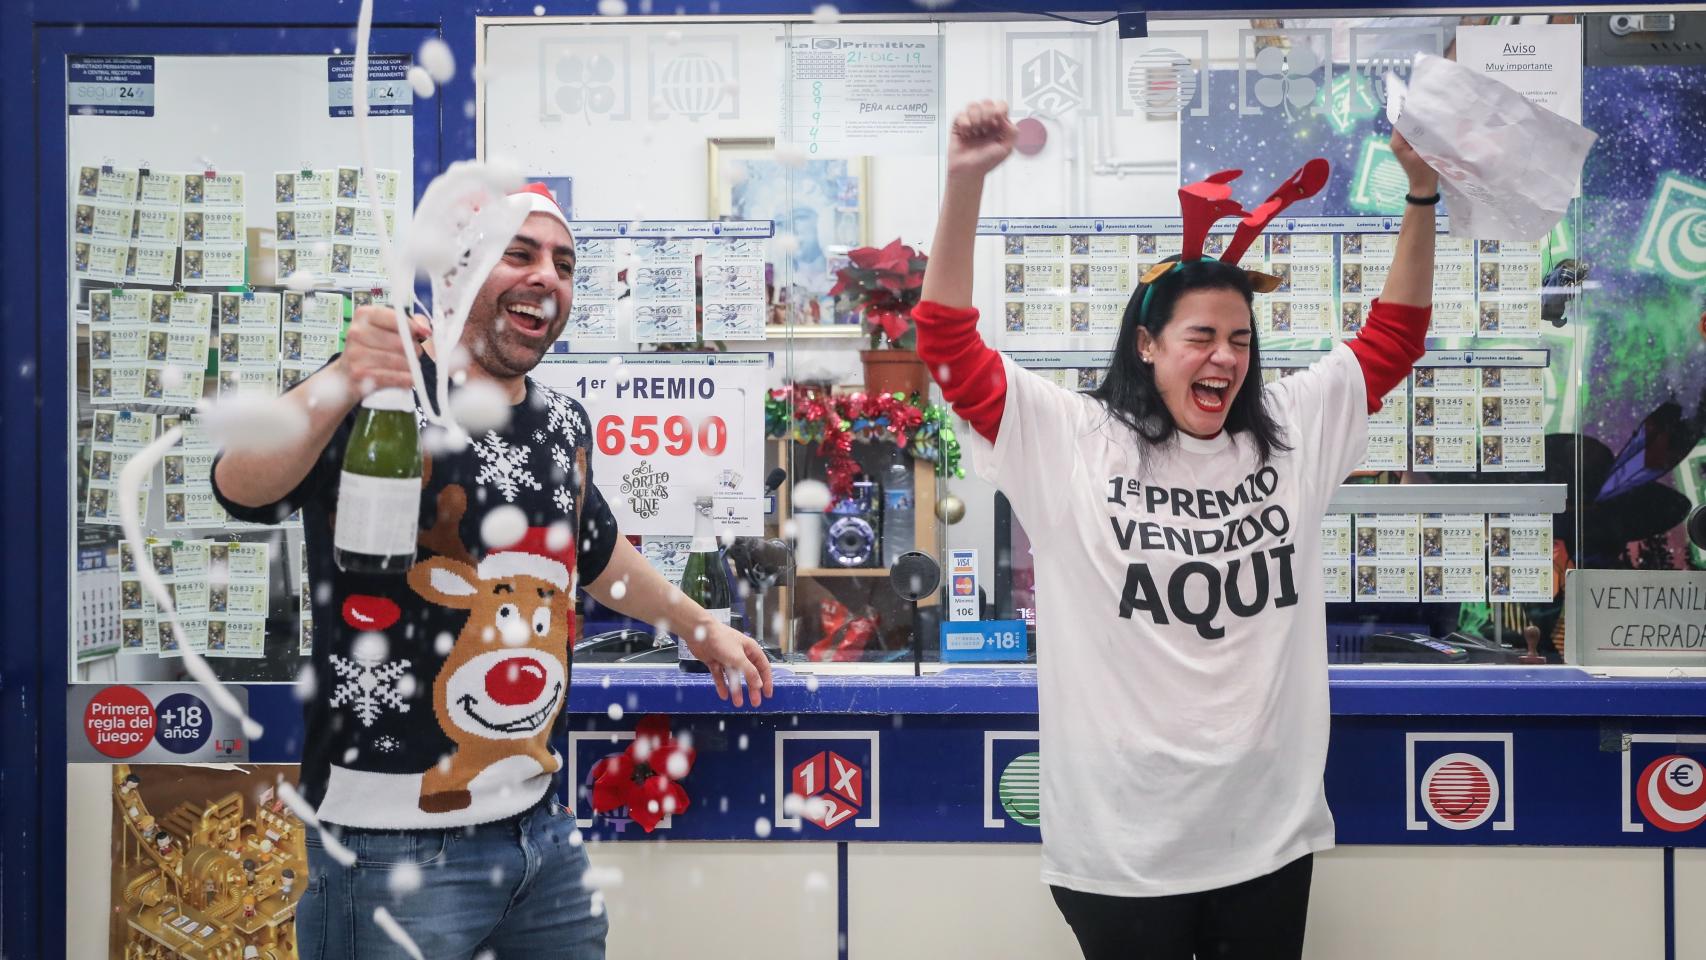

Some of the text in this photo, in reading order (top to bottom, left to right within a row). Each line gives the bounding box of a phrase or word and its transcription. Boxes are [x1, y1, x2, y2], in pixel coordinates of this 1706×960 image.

[1503, 43, 1536, 54] Aviso
[1486, 62, 1552, 71] Muy importante
[859, 102, 928, 114] PEÑA ALCAMPO
[616, 378, 715, 400] PREMIO
[596, 414, 728, 456] 6590
[620, 472, 669, 494] SORTEO
[632, 485, 668, 500] QUE NOS
[1145, 466, 1278, 520] PREMIO
[628, 497, 660, 520] UNE
[1110, 505, 1290, 556] VENDIDO
[1118, 538, 1299, 640] AQUÍ
[986, 632, 1014, 648] +18
[92, 703, 150, 715] Primera
[161, 706, 202, 728] +18
[88, 716, 153, 731] regla del
[96, 731, 144, 744] juego:
[164, 726, 200, 739] años
